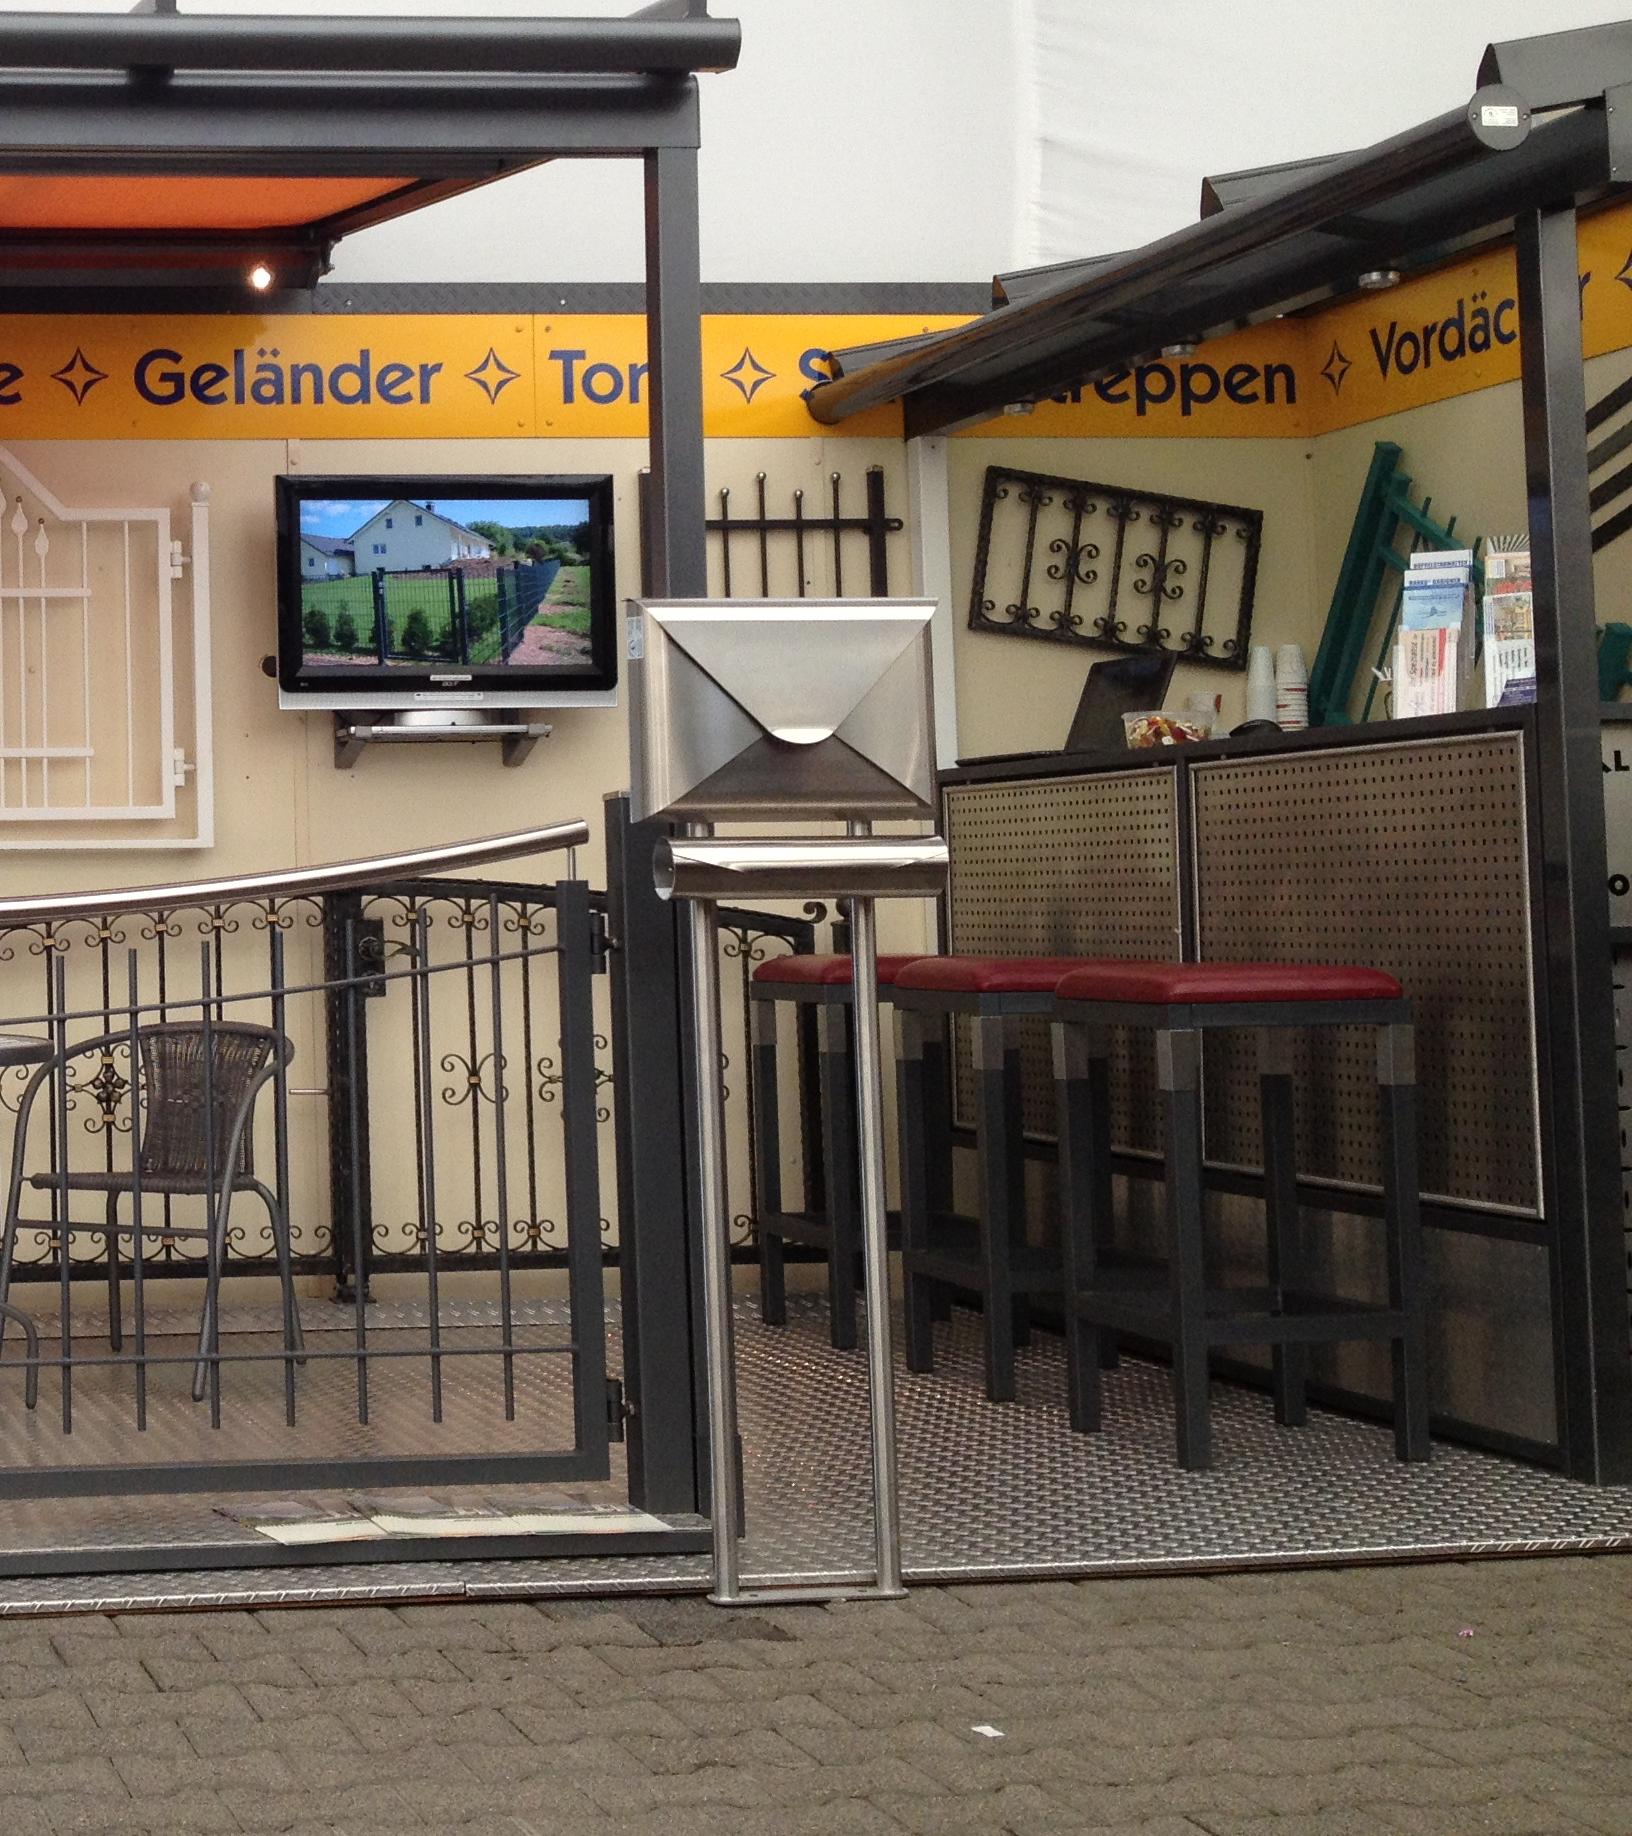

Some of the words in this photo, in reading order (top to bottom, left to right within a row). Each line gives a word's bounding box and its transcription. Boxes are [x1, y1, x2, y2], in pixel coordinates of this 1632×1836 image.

[1369, 271, 1592, 381] Vordäcr
[134, 347, 443, 406] Geländer
[549, 350, 649, 404] Tor
